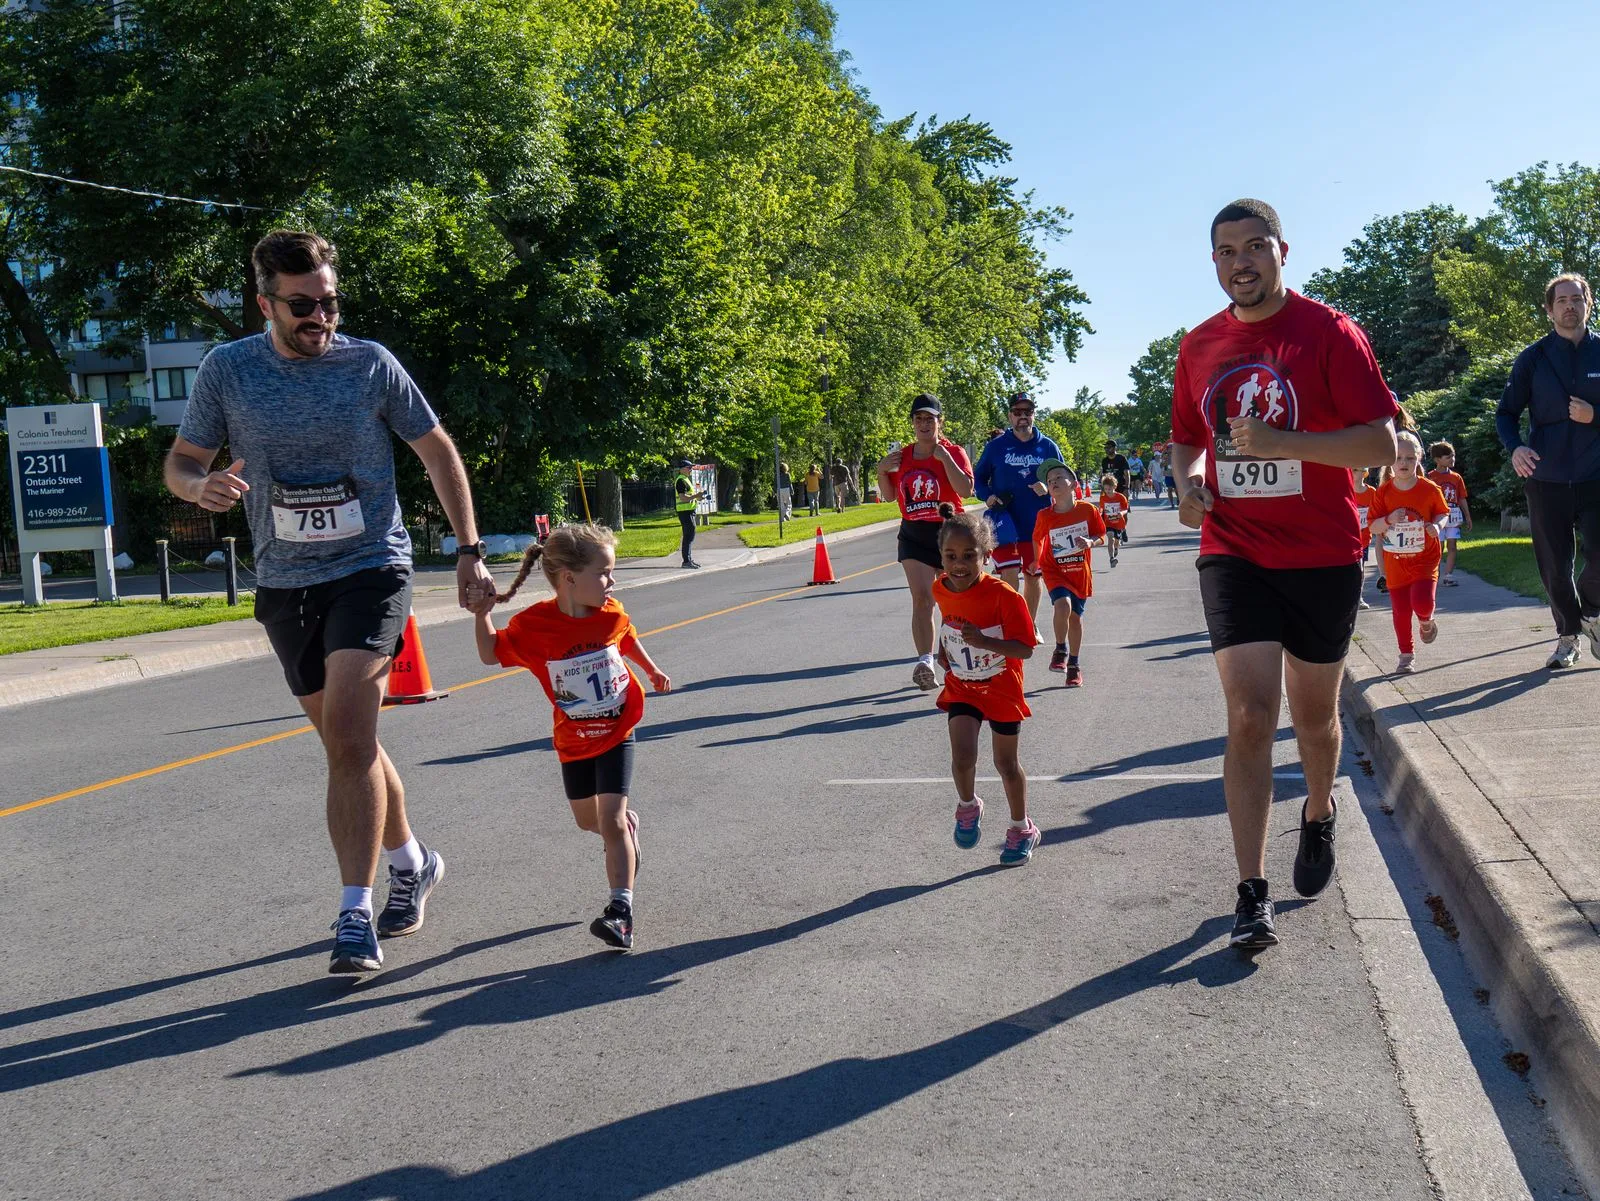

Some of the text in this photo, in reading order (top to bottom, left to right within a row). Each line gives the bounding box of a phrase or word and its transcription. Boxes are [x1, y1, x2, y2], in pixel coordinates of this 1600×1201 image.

[17, 426, 87, 439] Colonia Treuhand
[24, 454, 66, 475] 2311
[25, 476, 83, 487] Ontario Street
[1231, 462, 1278, 487] 690
[26, 488, 39, 496] The
[28, 507, 88, 518] 416-989-2647
[906, 502, 931, 513] CLASSIC
[294, 508, 337, 531] 781
[1066, 535, 1075, 548] 1
[1397, 532, 1404, 547] 1
[961, 647, 973, 671] 1
[564, 668, 580, 676] KIDS
[592, 660, 604, 670] FUN
[586, 672, 604, 701] 1
